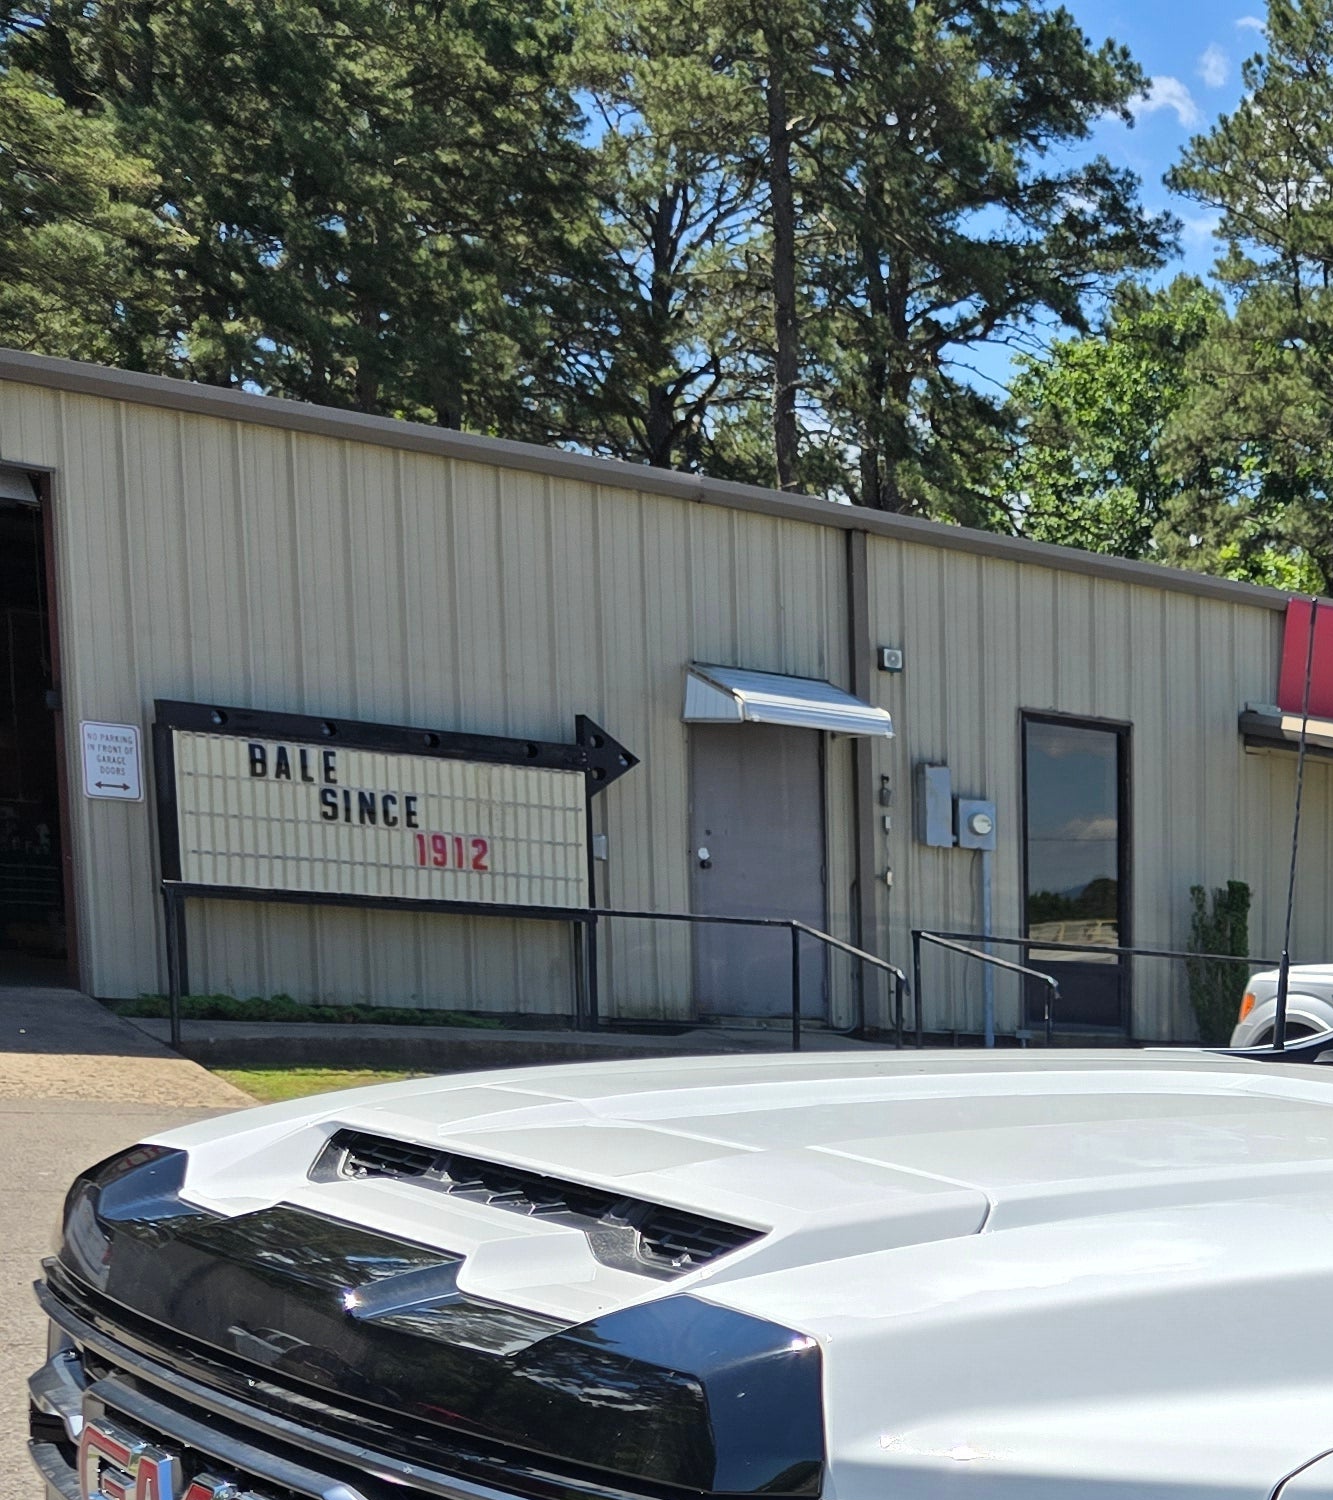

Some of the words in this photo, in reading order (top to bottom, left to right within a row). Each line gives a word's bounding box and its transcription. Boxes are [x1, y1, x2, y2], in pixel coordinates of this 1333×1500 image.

[248, 743, 338, 784] BALE
[320, 788, 419, 829] SINCE
[416, 834, 489, 871] 1912
